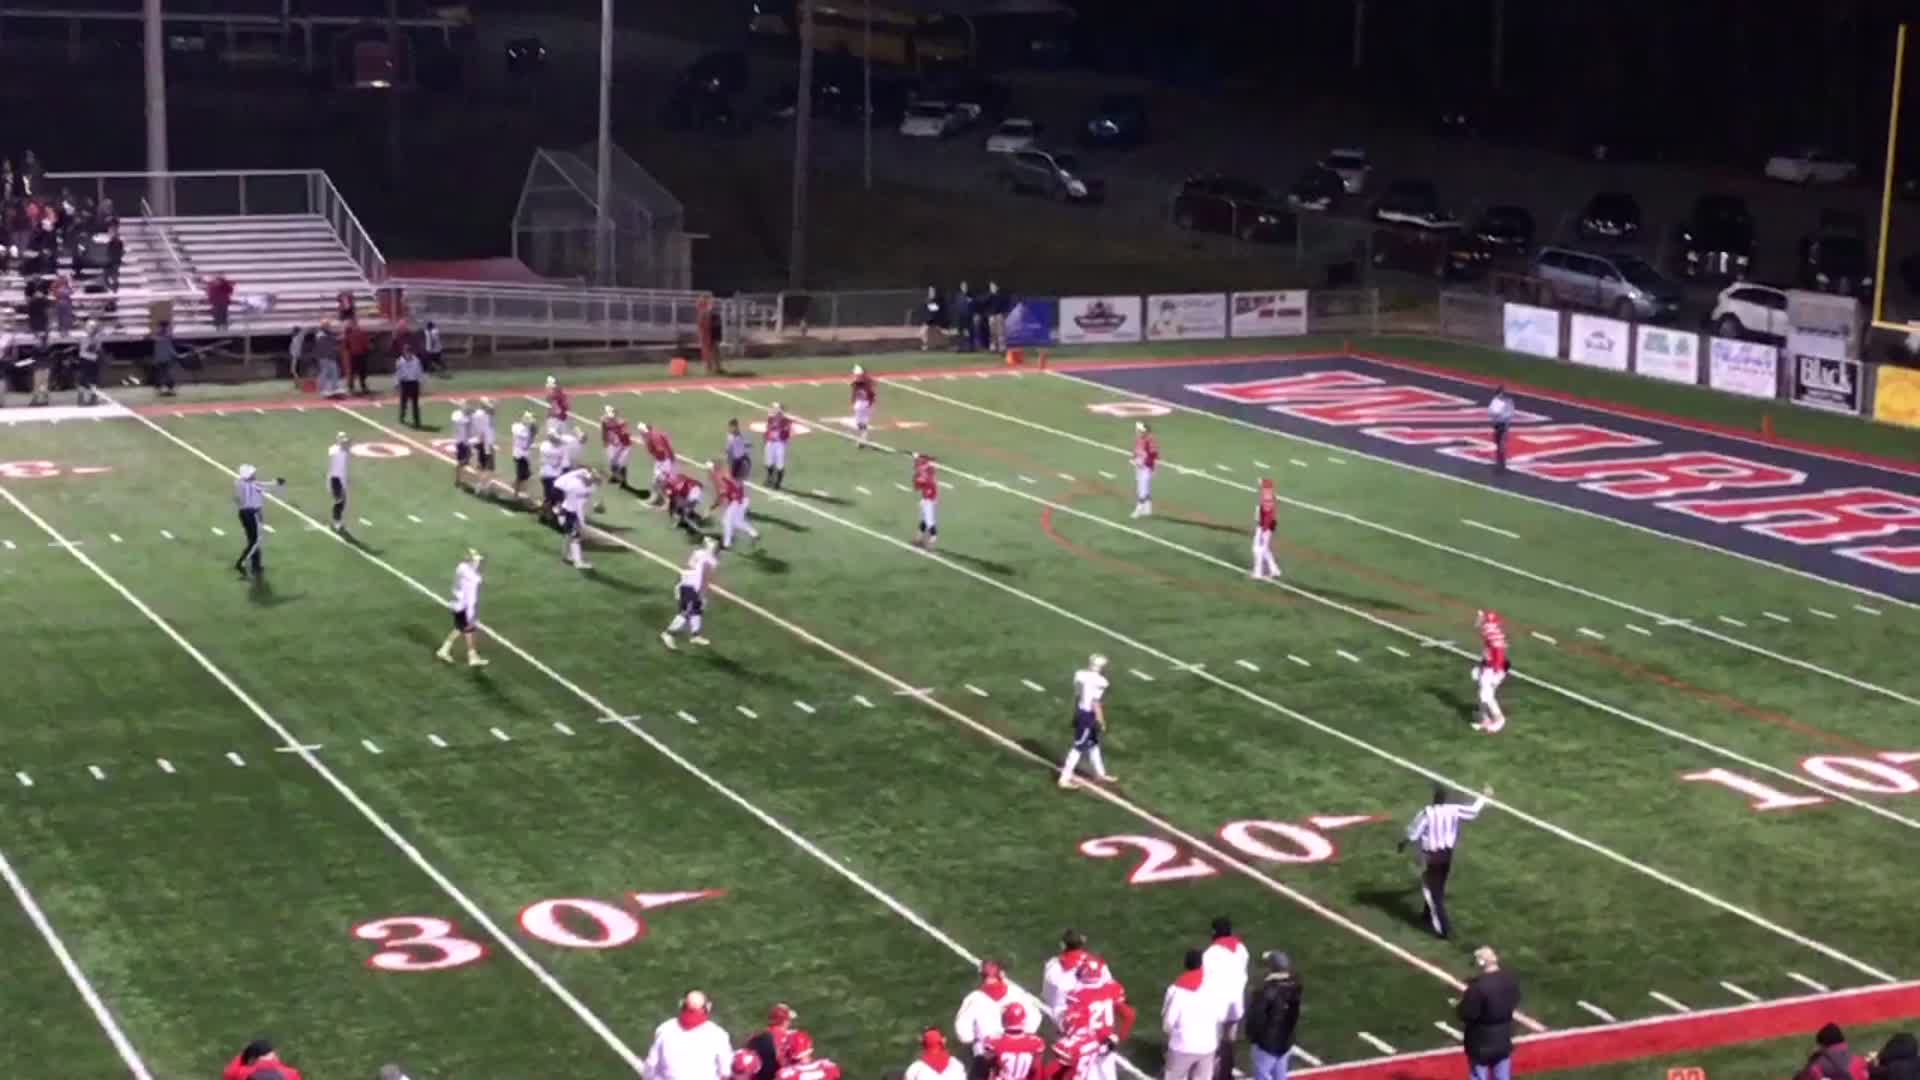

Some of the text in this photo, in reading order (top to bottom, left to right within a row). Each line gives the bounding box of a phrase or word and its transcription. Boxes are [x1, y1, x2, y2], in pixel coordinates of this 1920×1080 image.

[1183, 370, 1920, 575] WARR
[1079, 820, 1338, 884] 20
[352, 898, 645, 971] 30
[1088, 999, 1114, 1030] 21
